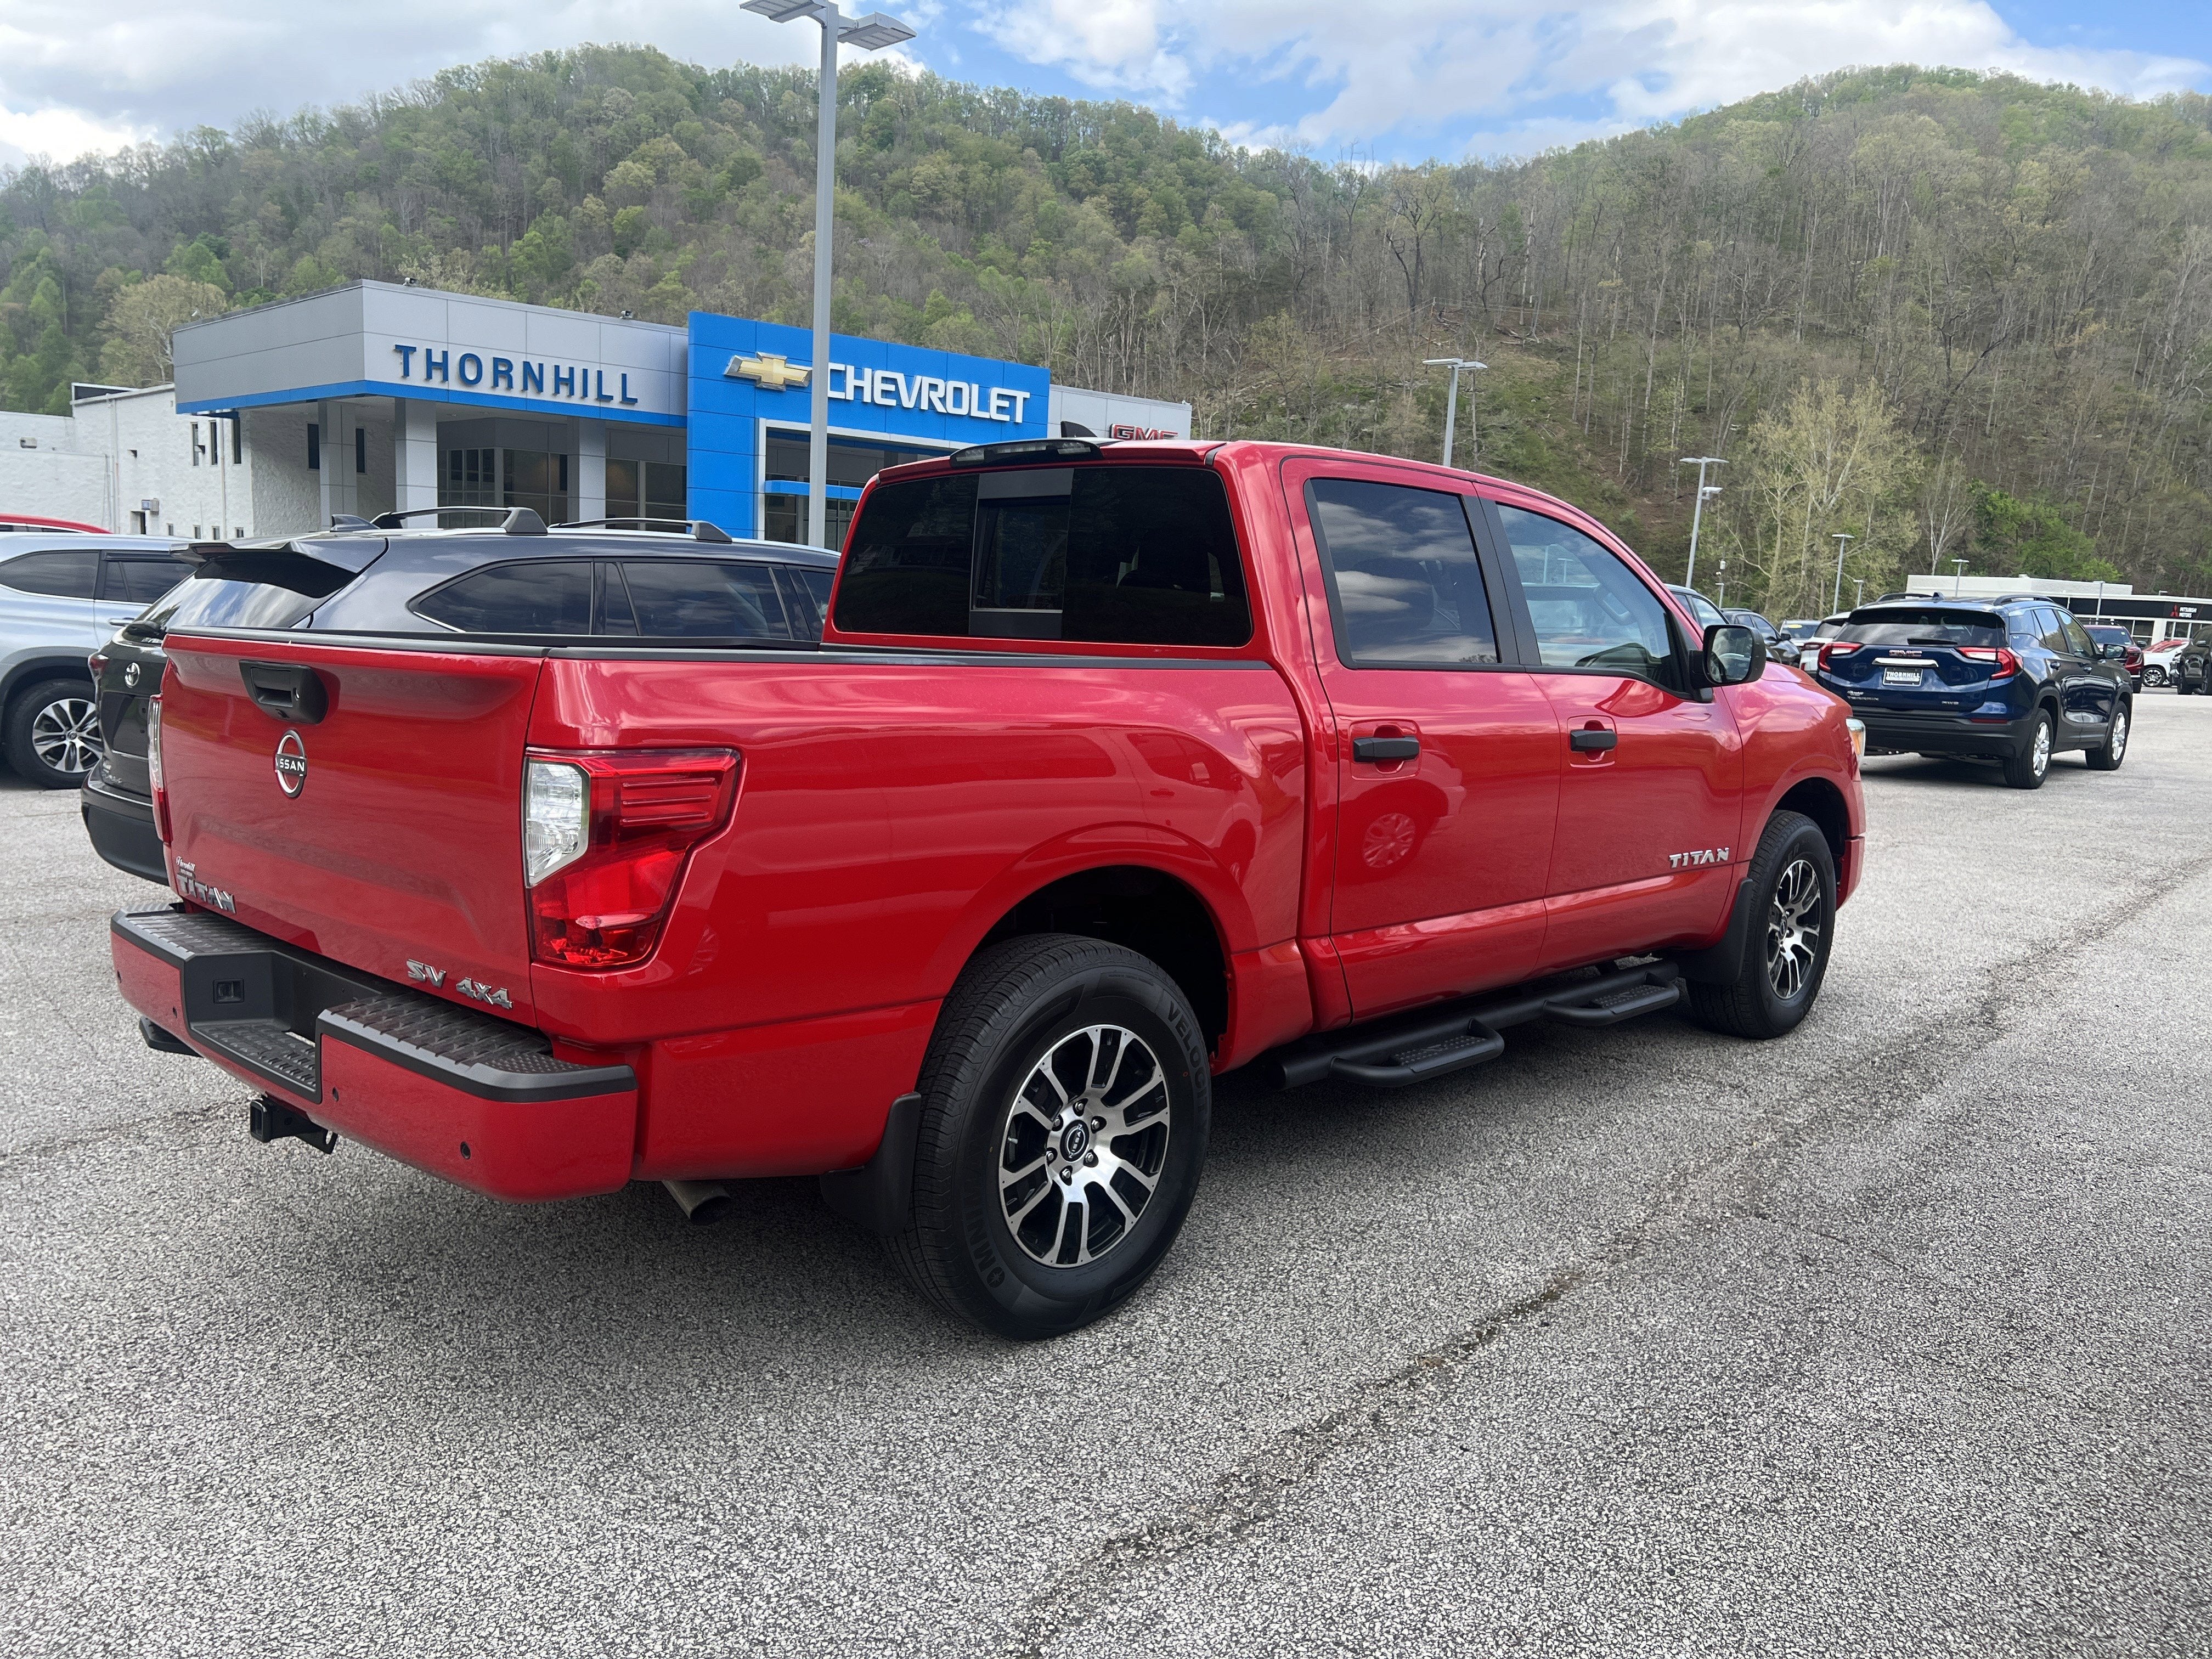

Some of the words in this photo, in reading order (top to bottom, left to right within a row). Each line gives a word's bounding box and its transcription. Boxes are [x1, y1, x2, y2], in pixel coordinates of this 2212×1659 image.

[394, 344, 638, 404] THORNHILL
[827, 362, 1030, 423] CHEVROLET
[275, 757, 305, 772] SSAN
[1669, 847, 1730, 869] TITAN
[176, 873, 237, 915] TITAN
[406, 958, 447, 989] SV
